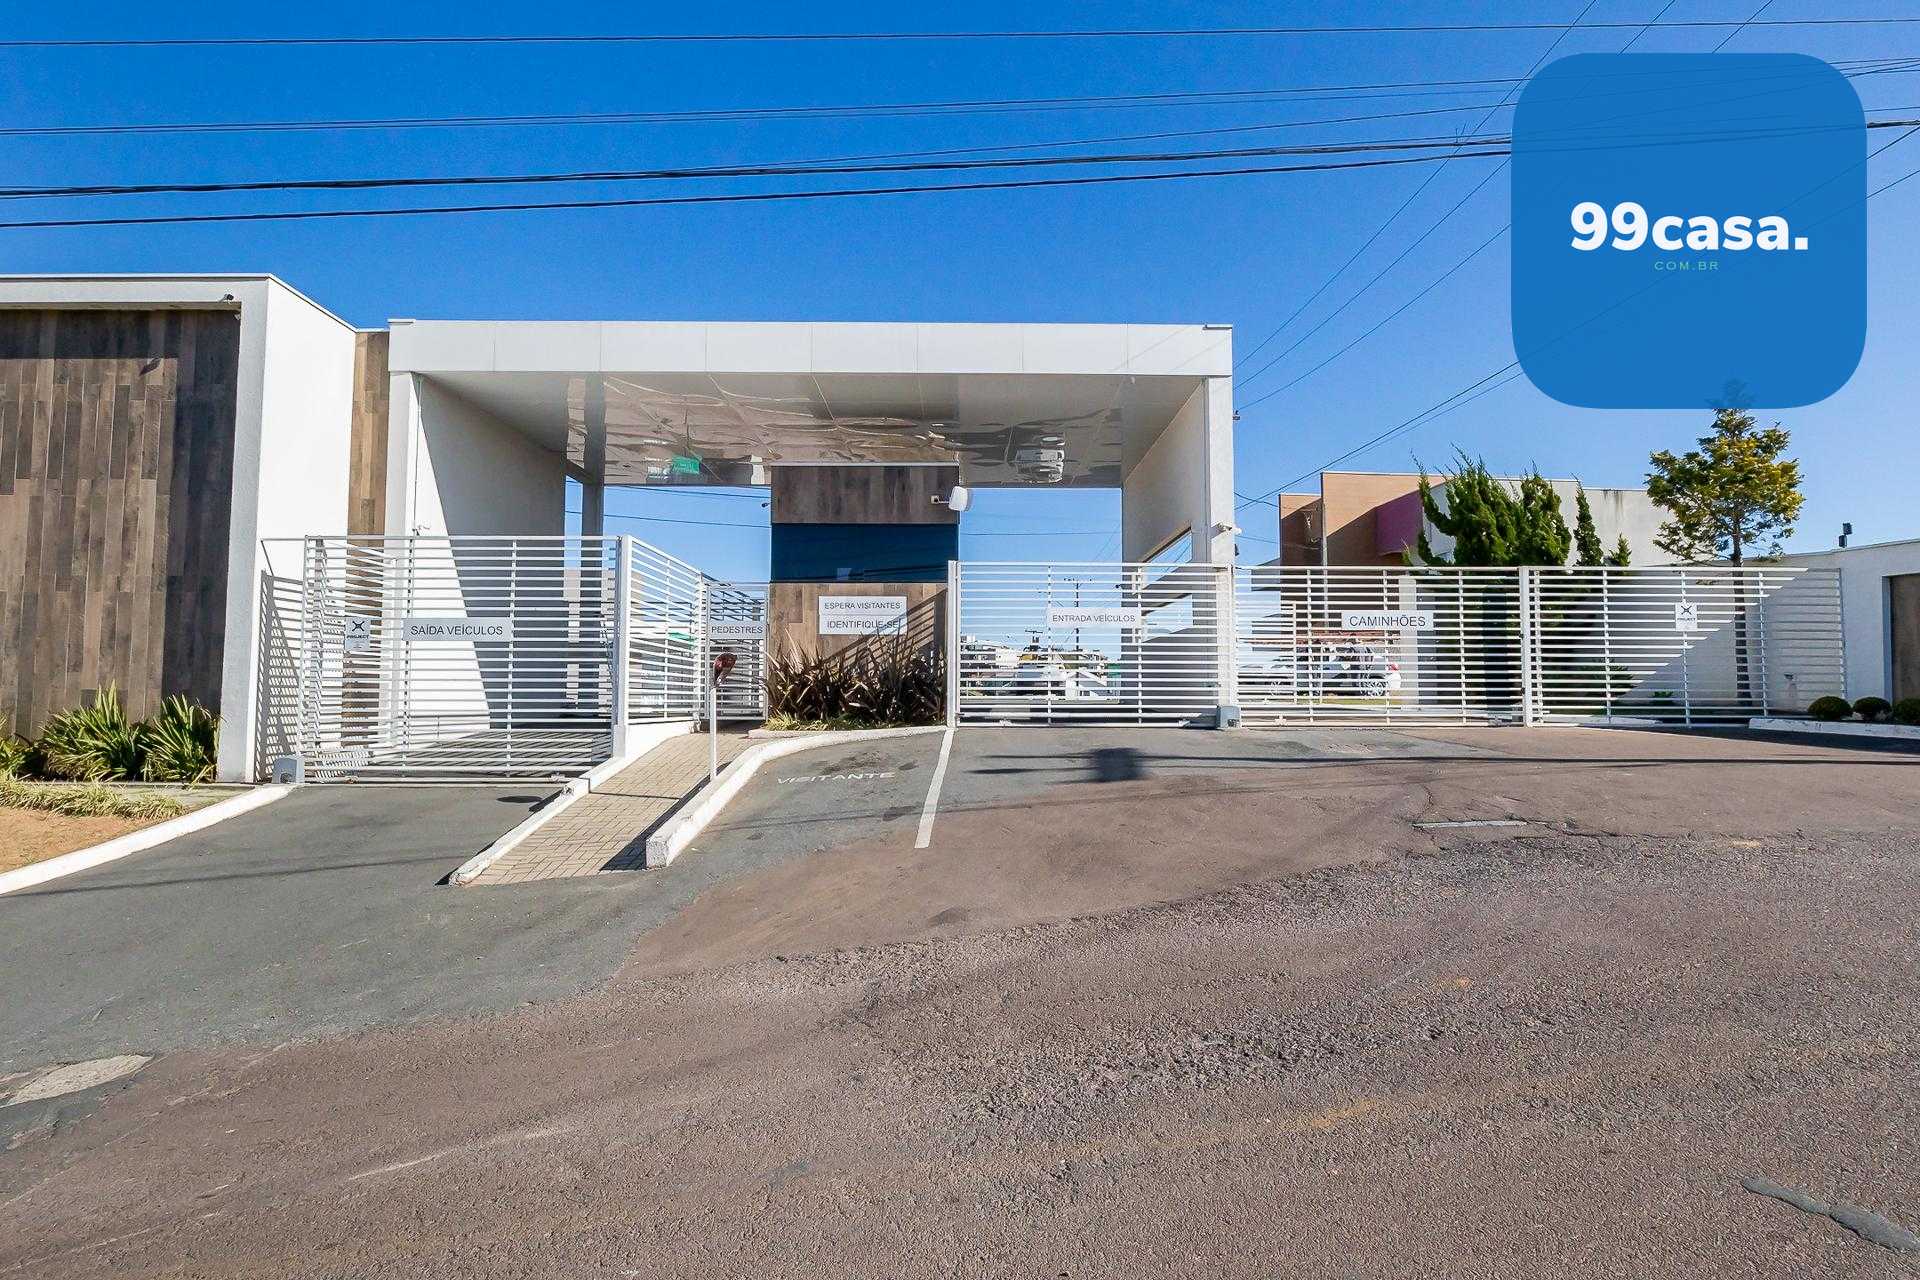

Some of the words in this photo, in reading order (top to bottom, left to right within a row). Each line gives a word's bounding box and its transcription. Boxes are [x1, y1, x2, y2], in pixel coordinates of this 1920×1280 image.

[824, 602, 856, 610] ESPERA
[856, 602, 901, 610] VISITANTES
[1052, 614, 1093, 623] ENTRADA
[1093, 613, 1136, 623] VEÍCULOS
[1349, 614, 1426, 627] CAMINHÕES
[410, 624, 444, 636] SAÍDA
[446, 624, 503, 636] VEÍCULOS
[711, 625, 763, 634] PEDESTRES
